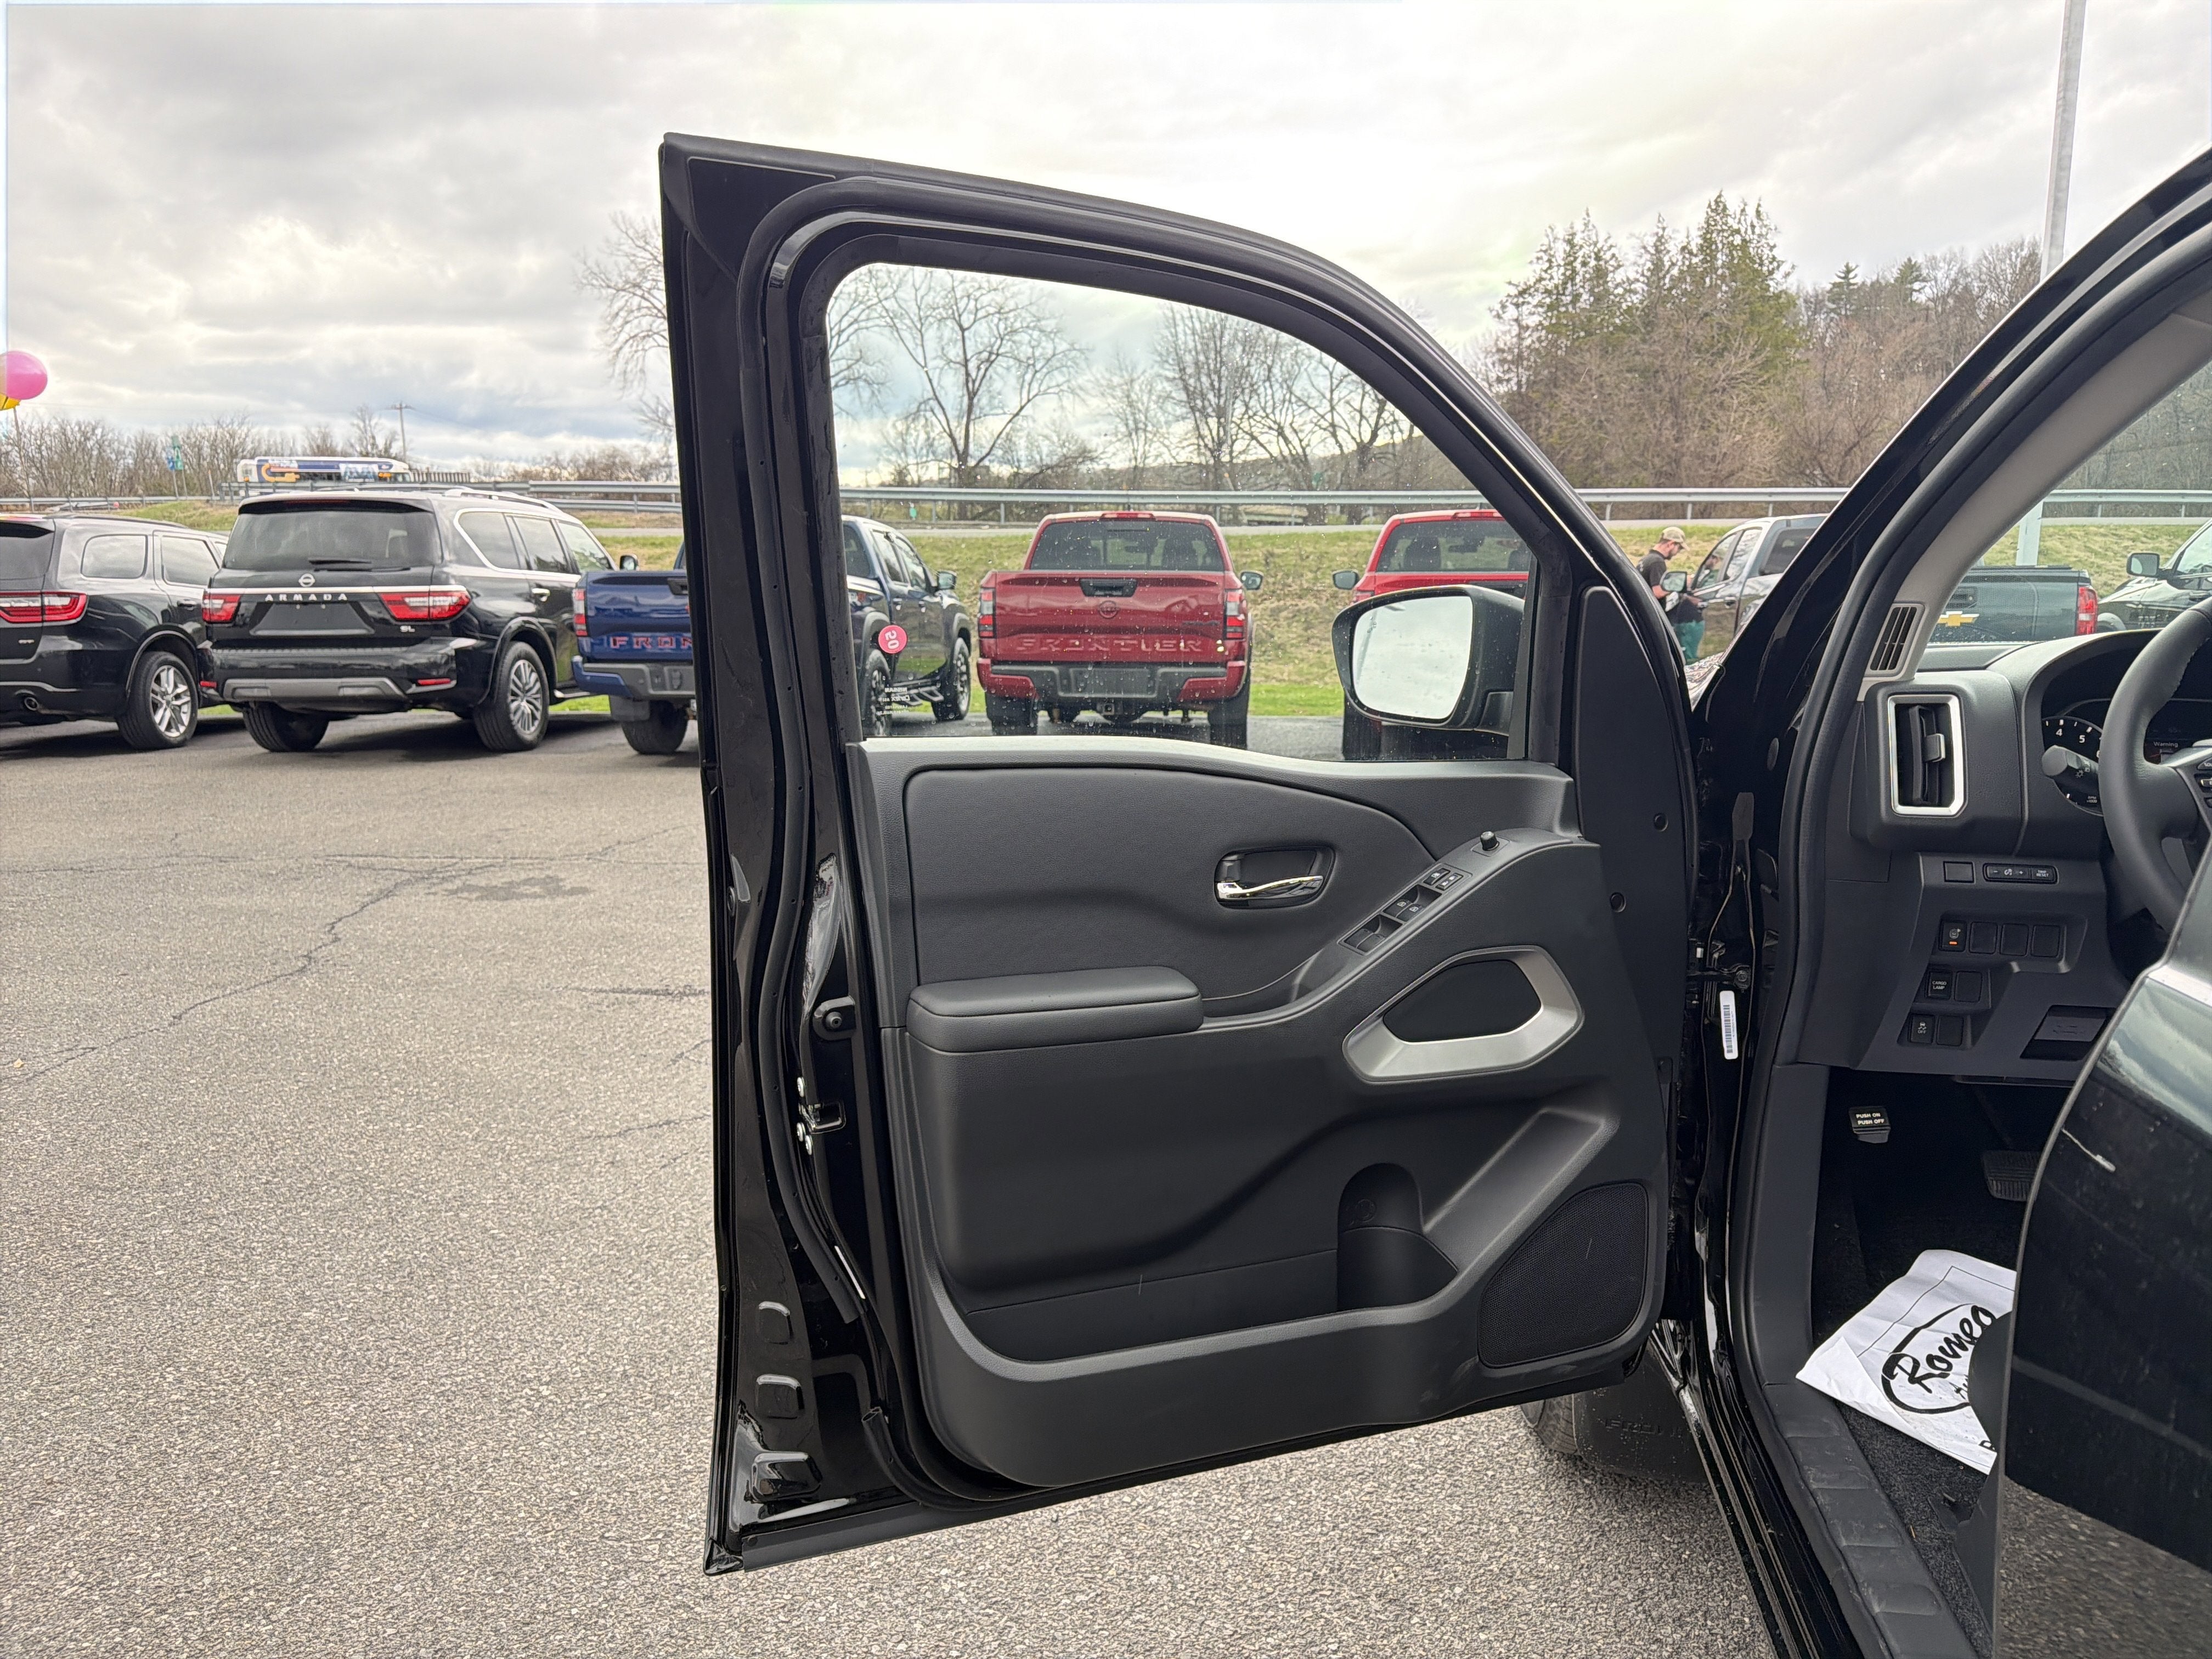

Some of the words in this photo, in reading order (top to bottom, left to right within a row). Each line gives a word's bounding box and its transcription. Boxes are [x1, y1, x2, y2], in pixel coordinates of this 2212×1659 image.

[264, 593, 347, 602] ARMADA
[1016, 637, 1203, 652] FRONTIER
[2079, 735, 2086, 743] 5
[1882, 1305, 1997, 1395] Romeo
